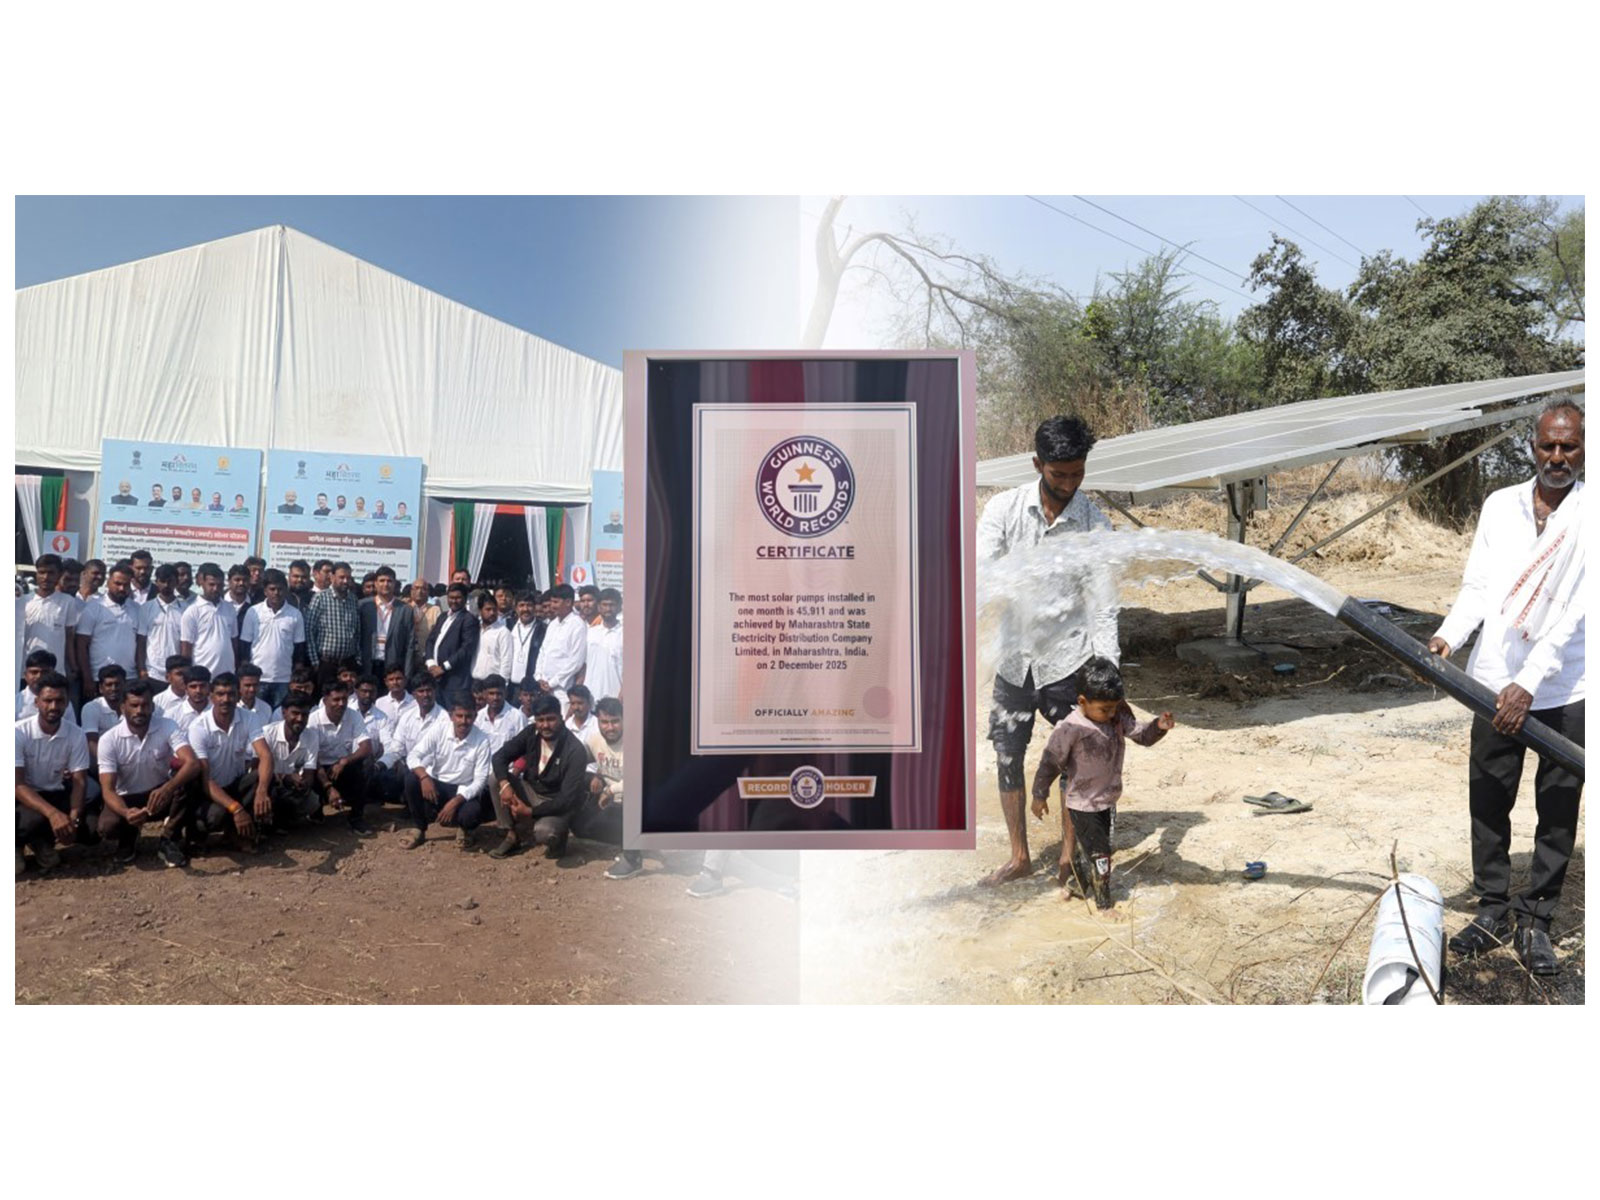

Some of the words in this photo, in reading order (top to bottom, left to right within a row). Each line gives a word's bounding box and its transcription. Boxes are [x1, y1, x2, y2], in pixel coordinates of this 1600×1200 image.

[770, 442, 841, 469] GUINNESS
[762, 480, 794, 528] WORLD
[800, 480, 849, 532] RECORDS
[756, 546, 855, 558] CERTIFICATE
[729, 592, 746, 602] The
[748, 593, 770, 602] most
[771, 592, 793, 602] solar
[796, 594, 825, 604] pumps
[827, 592, 865, 602] installed
[867, 592, 875, 602] in
[738, 608, 754, 616] one
[756, 606, 784, 616] month
[786, 606, 794, 616] is
[828, 606, 844, 616] and
[847, 608, 866, 616] was
[733, 620, 773, 629] achieved
[776, 620, 785, 631] by
[788, 620, 844, 629] Maharashtra
[847, 620, 871, 629] State
[732, 633, 776, 644] Electricity
[779, 633, 829, 643] Distribution
[832, 633, 872, 644] Company
[772, 647, 781, 656] in
[756, 662, 768, 670] on
[770, 661, 776, 670] 2
[778, 661, 823, 670] December
[825, 661, 848, 670] 2025
[754, 708, 809, 717] OFFICIALLY
[811, 708, 855, 717] AMAZING
[748, 783, 788, 792] RECORD
[825, 782, 867, 792] HOLDER
